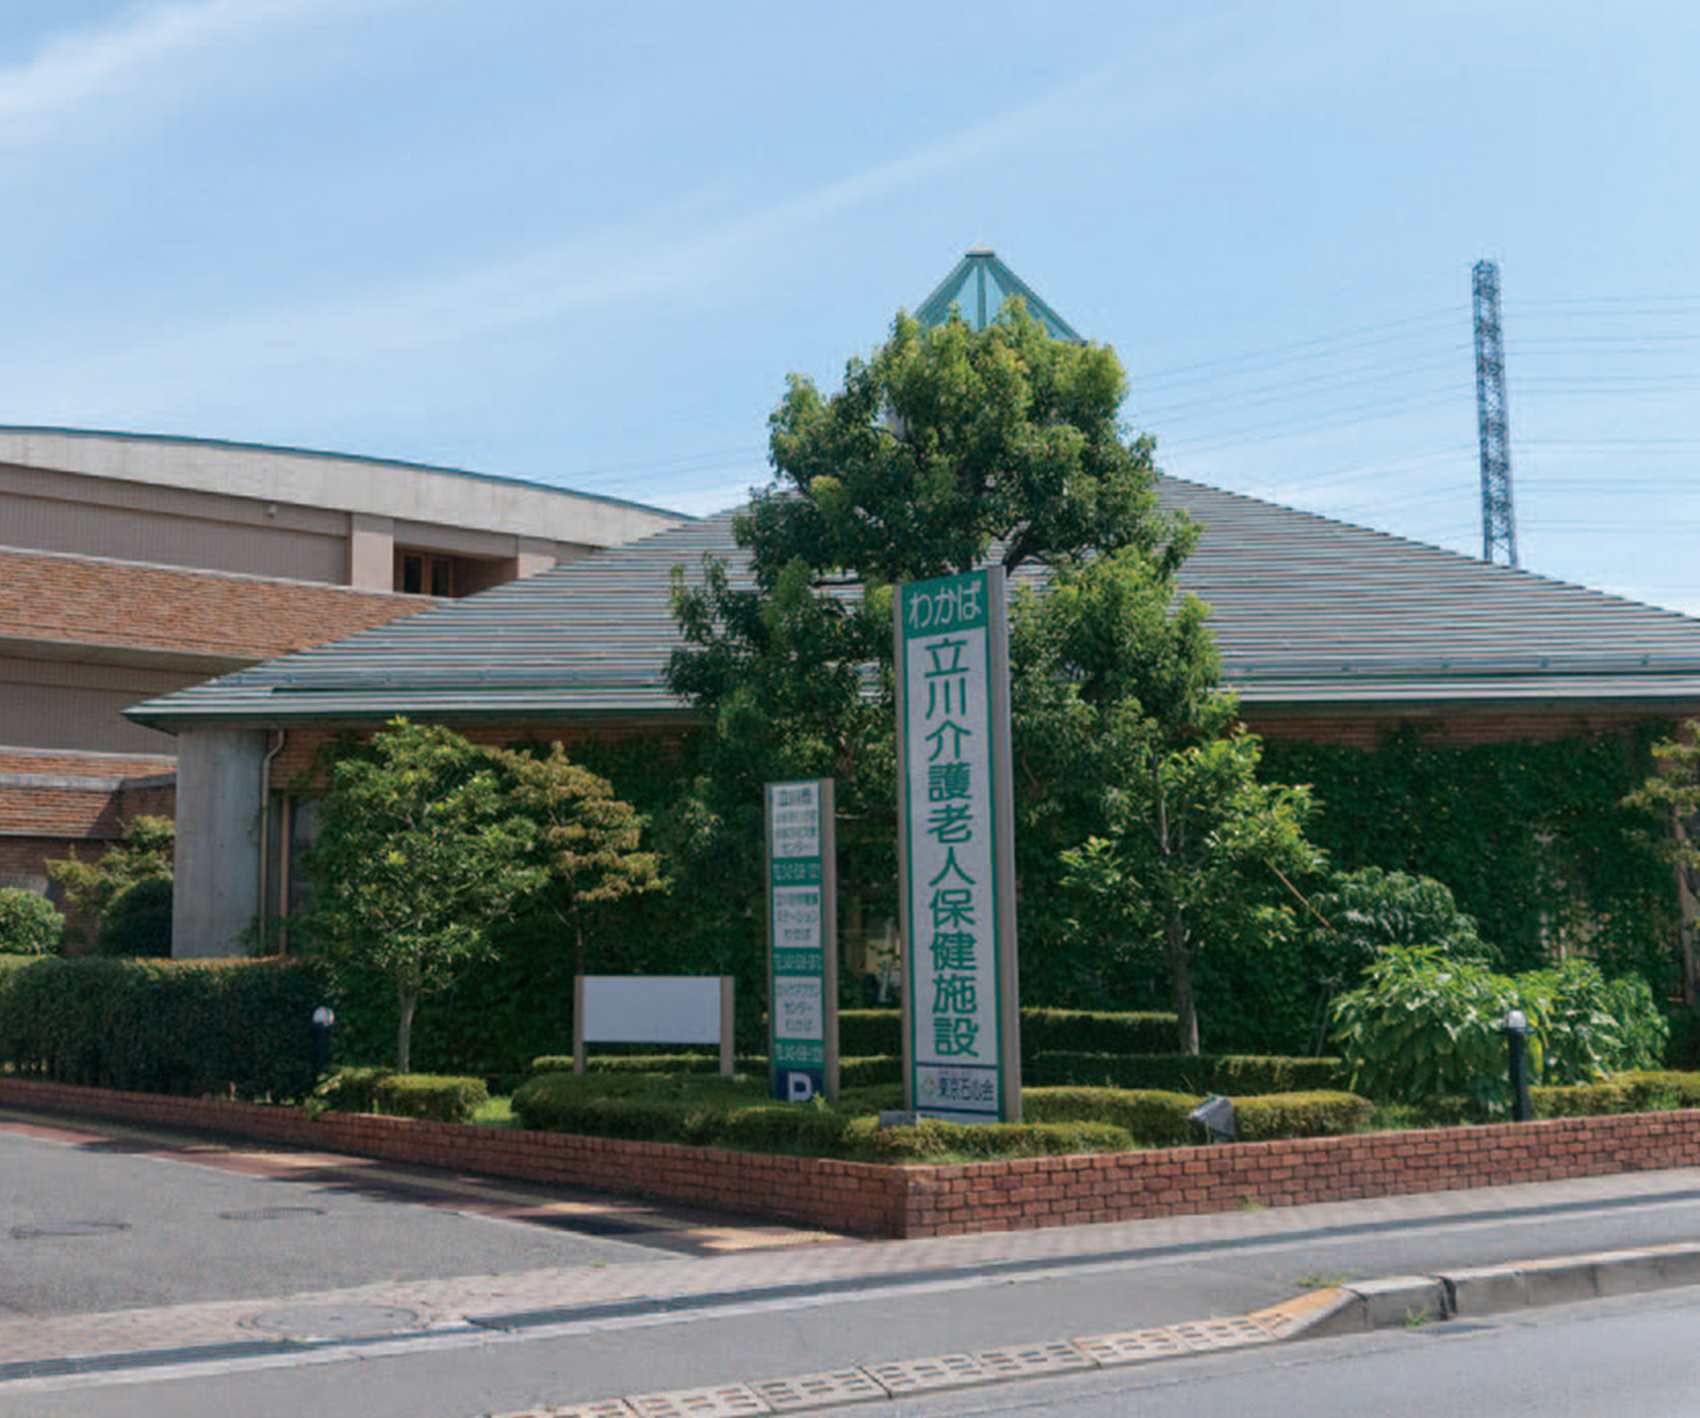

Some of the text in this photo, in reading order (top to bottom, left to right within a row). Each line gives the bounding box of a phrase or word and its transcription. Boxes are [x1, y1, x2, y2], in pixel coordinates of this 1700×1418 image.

[908, 580, 981, 629] わかば
[924, 637, 979, 1057] 立川介護老人保健施設
